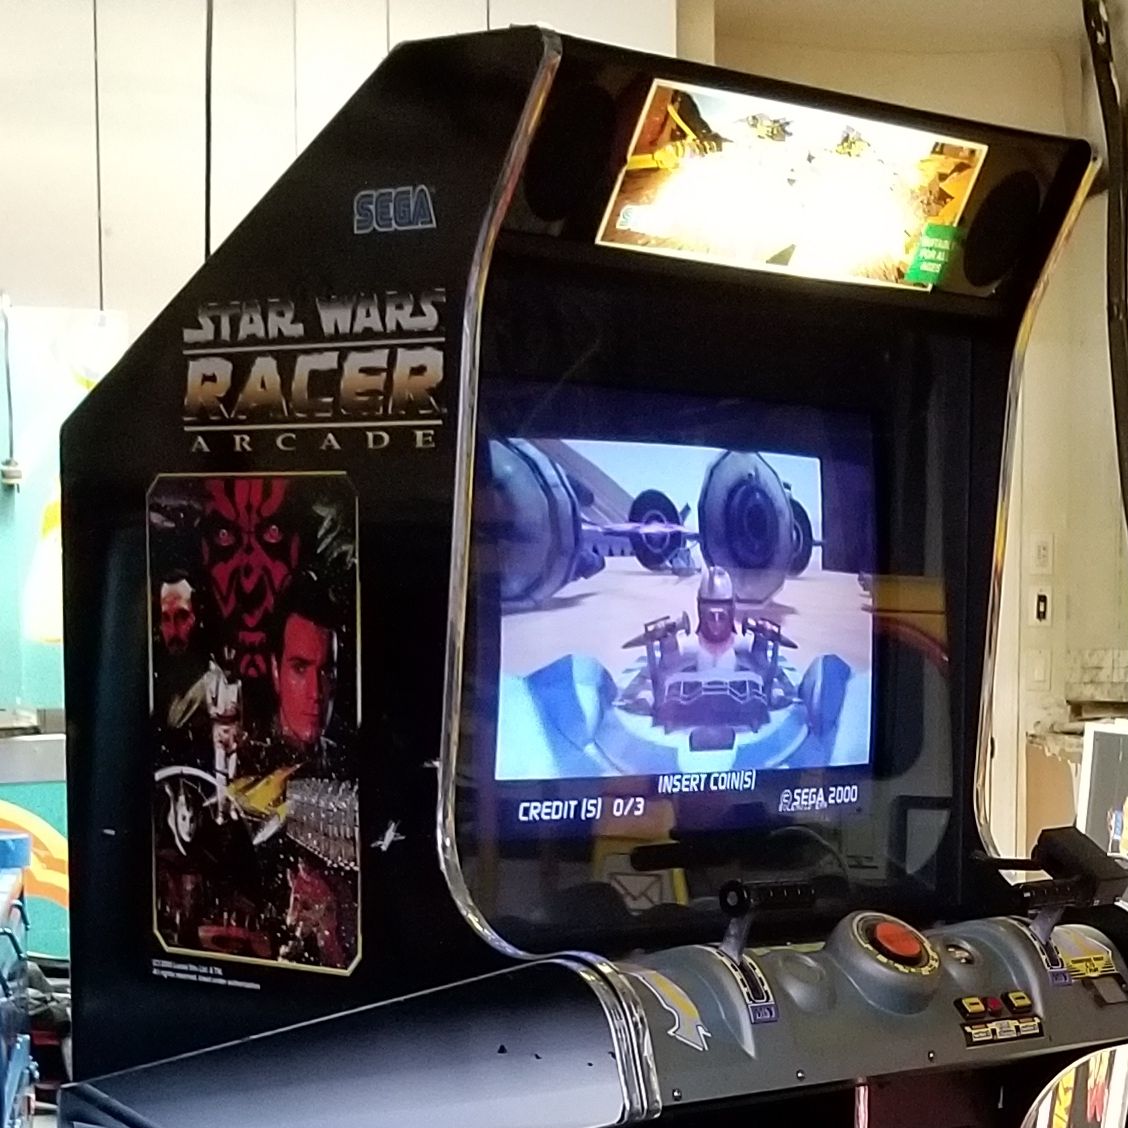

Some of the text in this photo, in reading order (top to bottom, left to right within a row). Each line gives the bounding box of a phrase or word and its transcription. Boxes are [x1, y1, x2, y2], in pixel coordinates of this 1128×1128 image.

[354, 184, 436, 234] SEGA
[183, 287, 446, 344] STAR WARS
[183, 346, 447, 421] RACER
[191, 429, 436, 453] ARCADE
[657, 769, 757, 794] INSERT COIN(S)
[827, 784, 859, 805] 2000
[518, 800, 578, 821] CREDIT
[612, 796, 646, 818] 0/3
